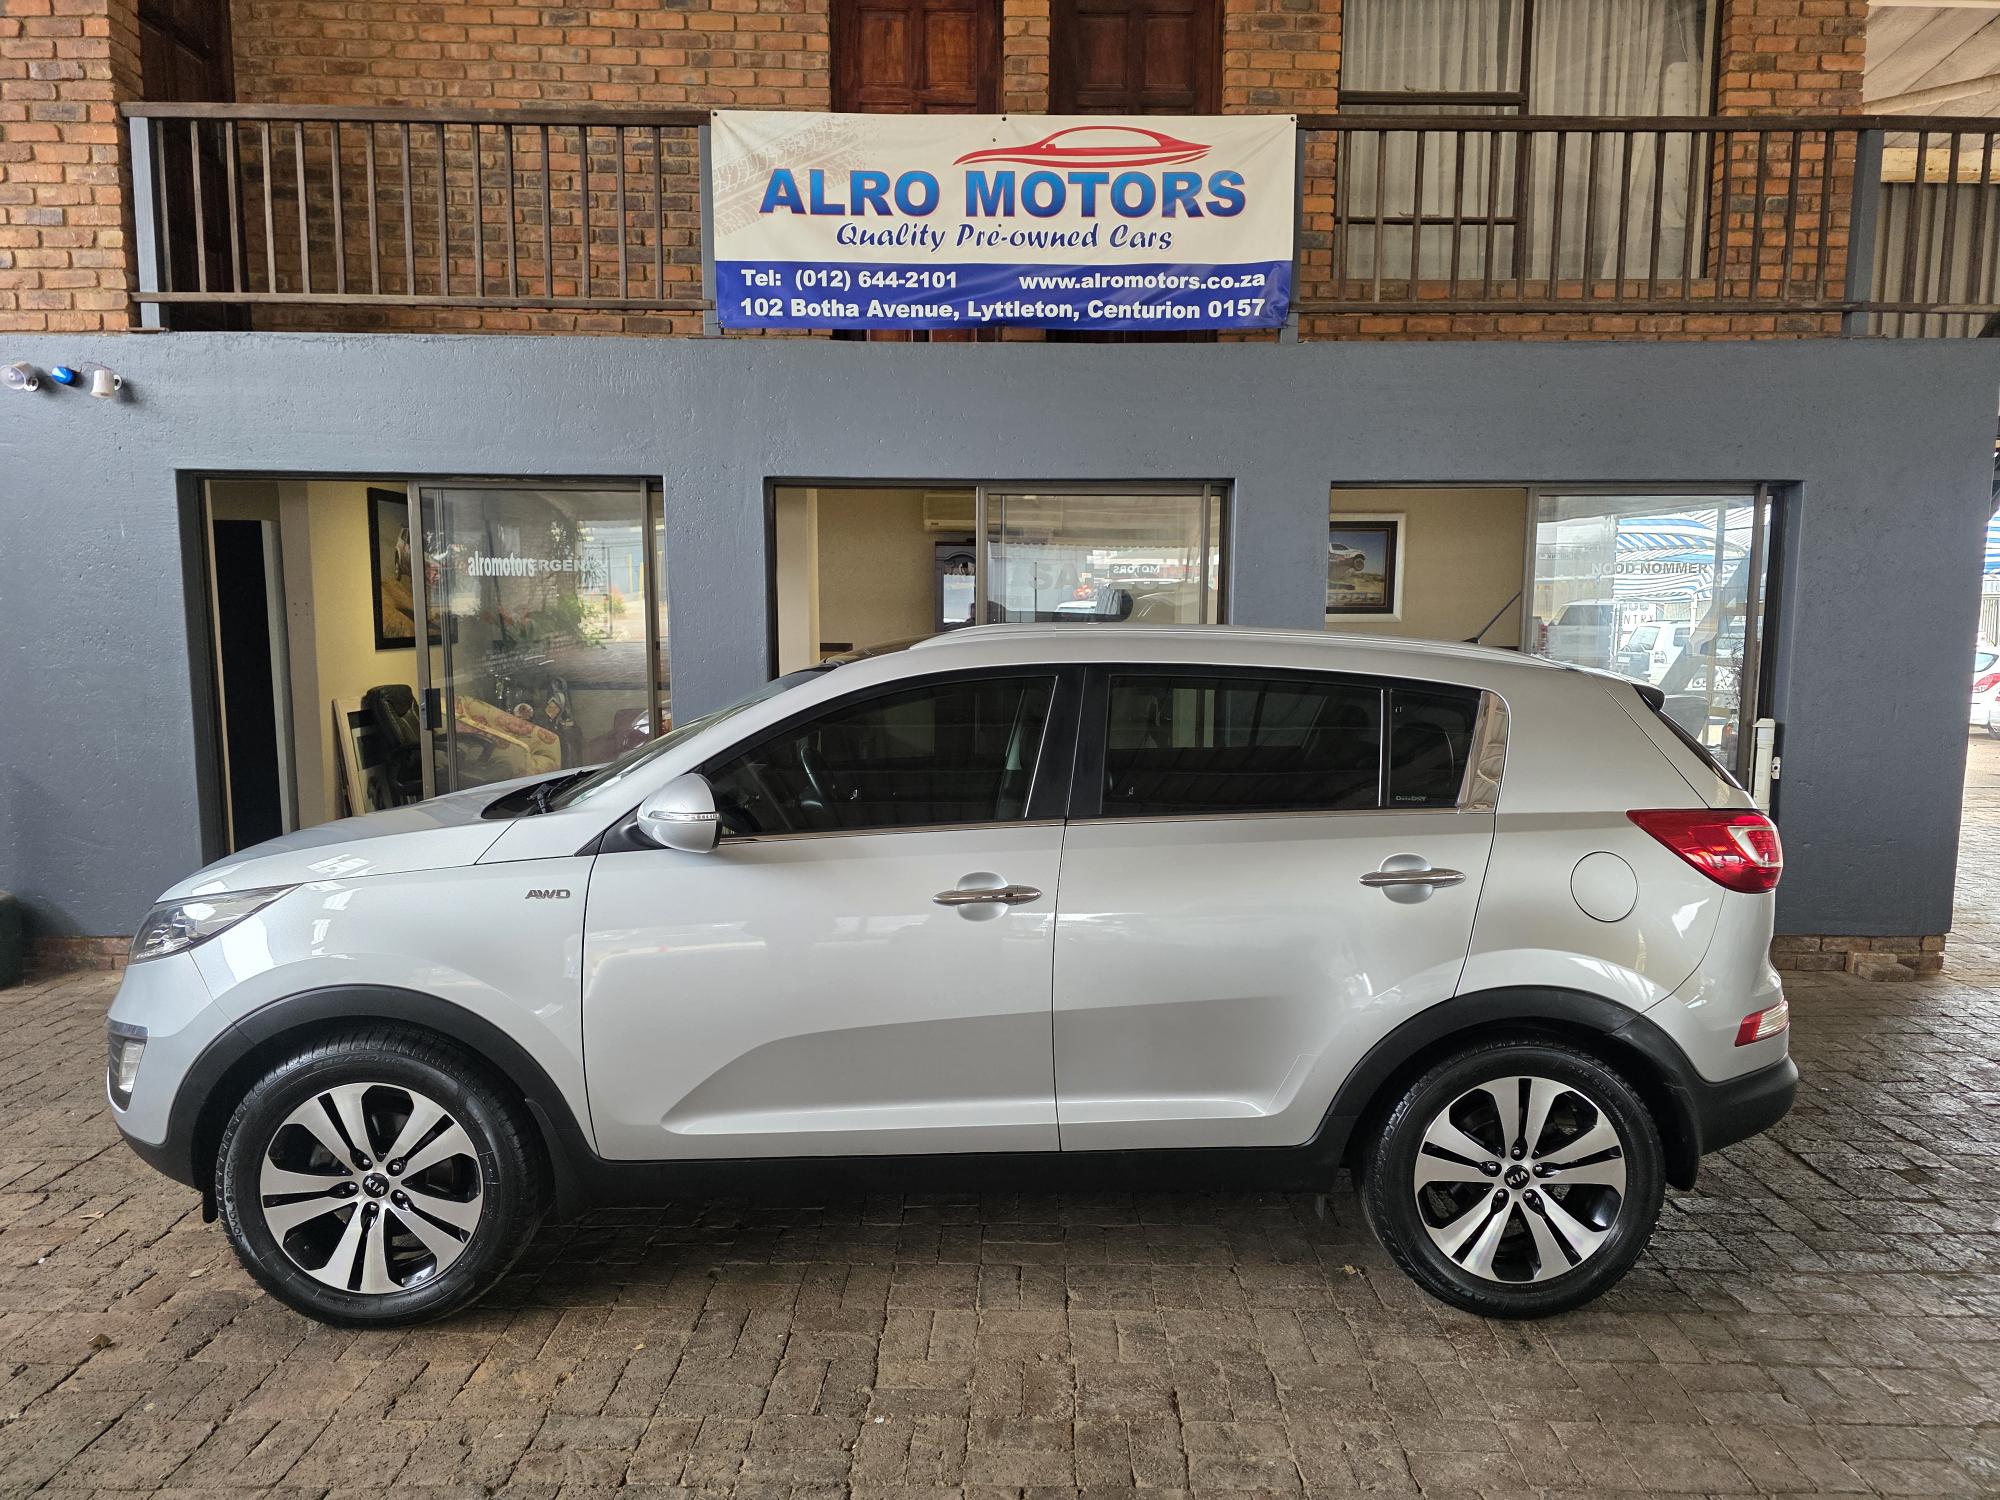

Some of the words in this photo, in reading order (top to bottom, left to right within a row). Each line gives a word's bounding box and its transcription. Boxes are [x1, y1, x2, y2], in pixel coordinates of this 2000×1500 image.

[758, 168, 941, 217] ALRO
[965, 169, 1247, 219] MOTORS
[836, 222, 946, 253] Quality
[956, 222, 1099, 249] Pre-owned
[1109, 224, 1173, 250] Cars
[740, 269, 782, 287] Tel:
[795, 269, 851, 291] (012)
[858, 270, 957, 289] 644-2101
[1019, 272, 1266, 290] www.alromotors.co.za
[740, 298, 784, 317] 102
[790, 299, 860, 318] Botha
[866, 299, 960, 320] Avenue,
[966, 300, 1080, 321] Lyttleton,
[1087, 300, 1201, 319] Centurion
[1207, 298, 1266, 318] 0157
[467, 551, 535, 577] alromotors
[1591, 562, 1636, 575] NOOD
[1640, 562, 1709, 575] NOMMER
[524, 889, 571, 899] AWD
[364, 1176, 385, 1195] KIA
[1506, 1170, 1529, 1186] KIA
